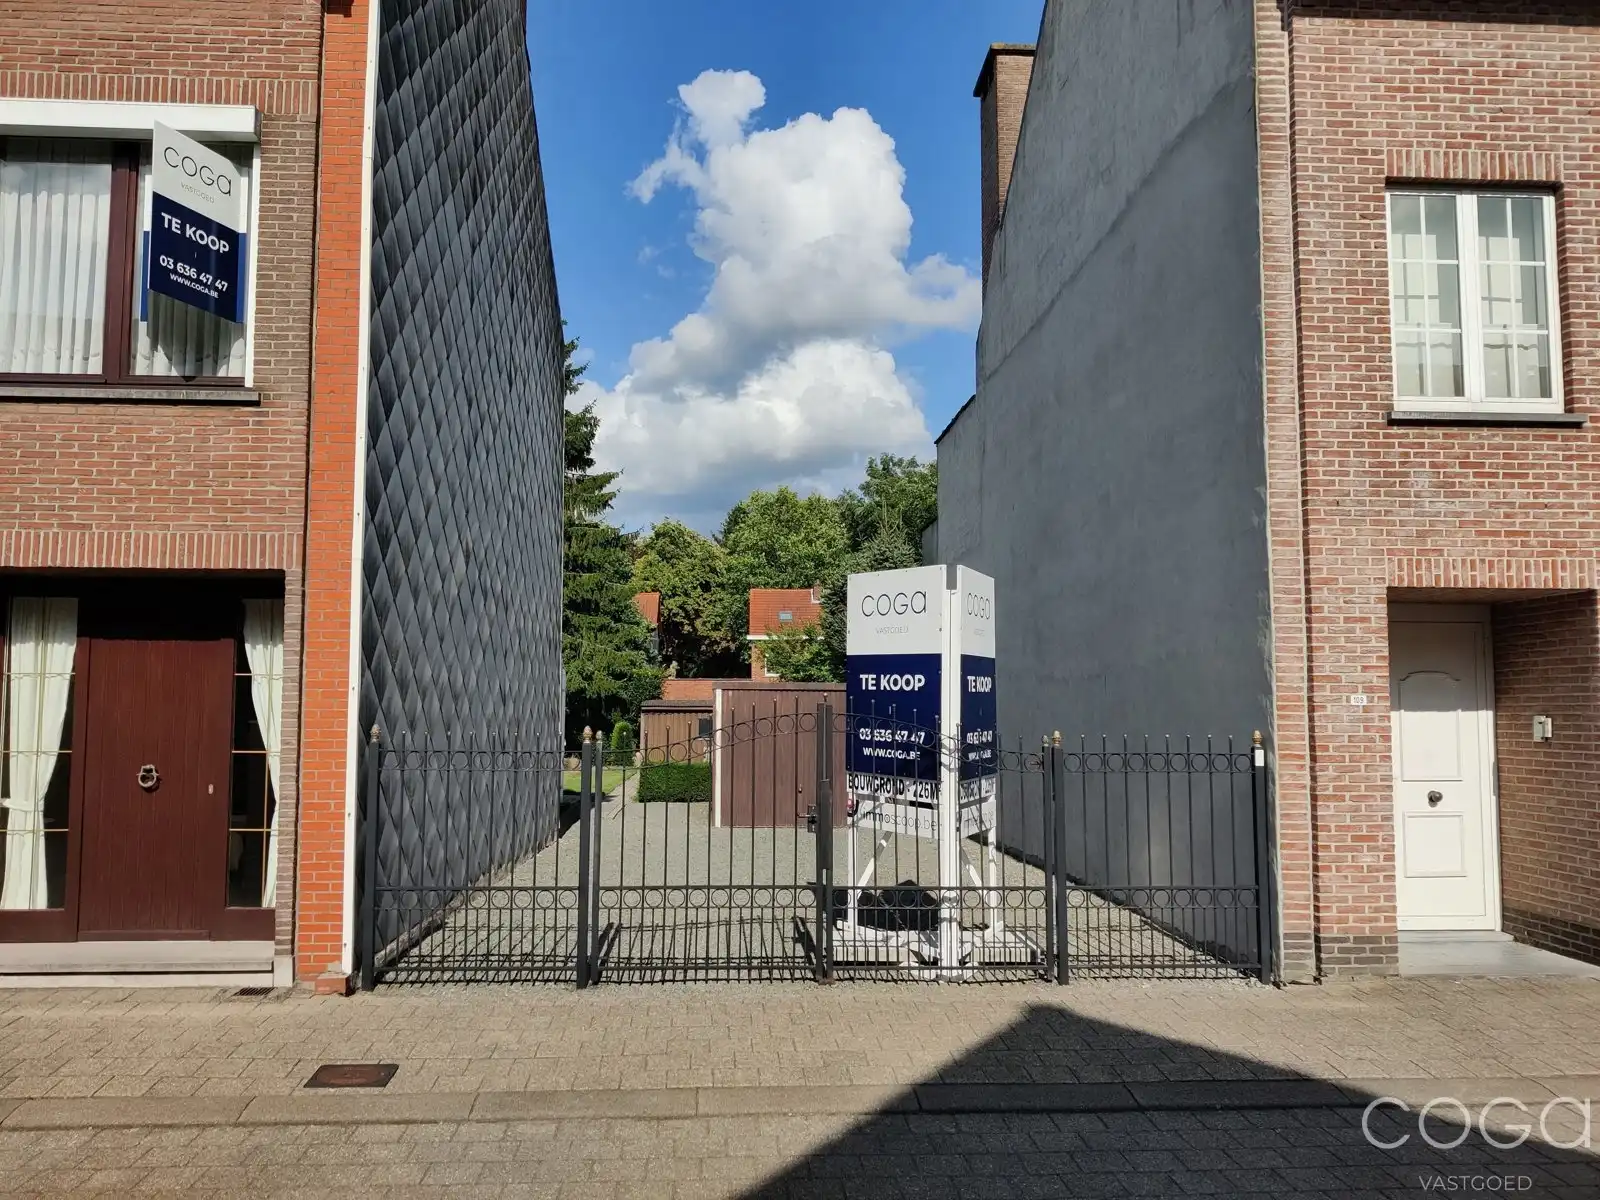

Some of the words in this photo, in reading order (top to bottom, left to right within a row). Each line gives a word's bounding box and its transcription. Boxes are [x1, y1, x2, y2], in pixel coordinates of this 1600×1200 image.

[161, 212, 181, 234] TE
[185, 223, 230, 254] KOOP
[159, 255, 174, 270] 03
[176, 262, 197, 280] 636
[199, 268, 213, 286] 47
[214, 276, 228, 292] 47
[169, 272, 219, 298] WWW.COGA.BE
[860, 674, 877, 690] TE
[880, 674, 926, 691] KOOP
[967, 676, 976, 692] TE
[976, 676, 992, 693] KOOP
[859, 728, 871, 740] 03
